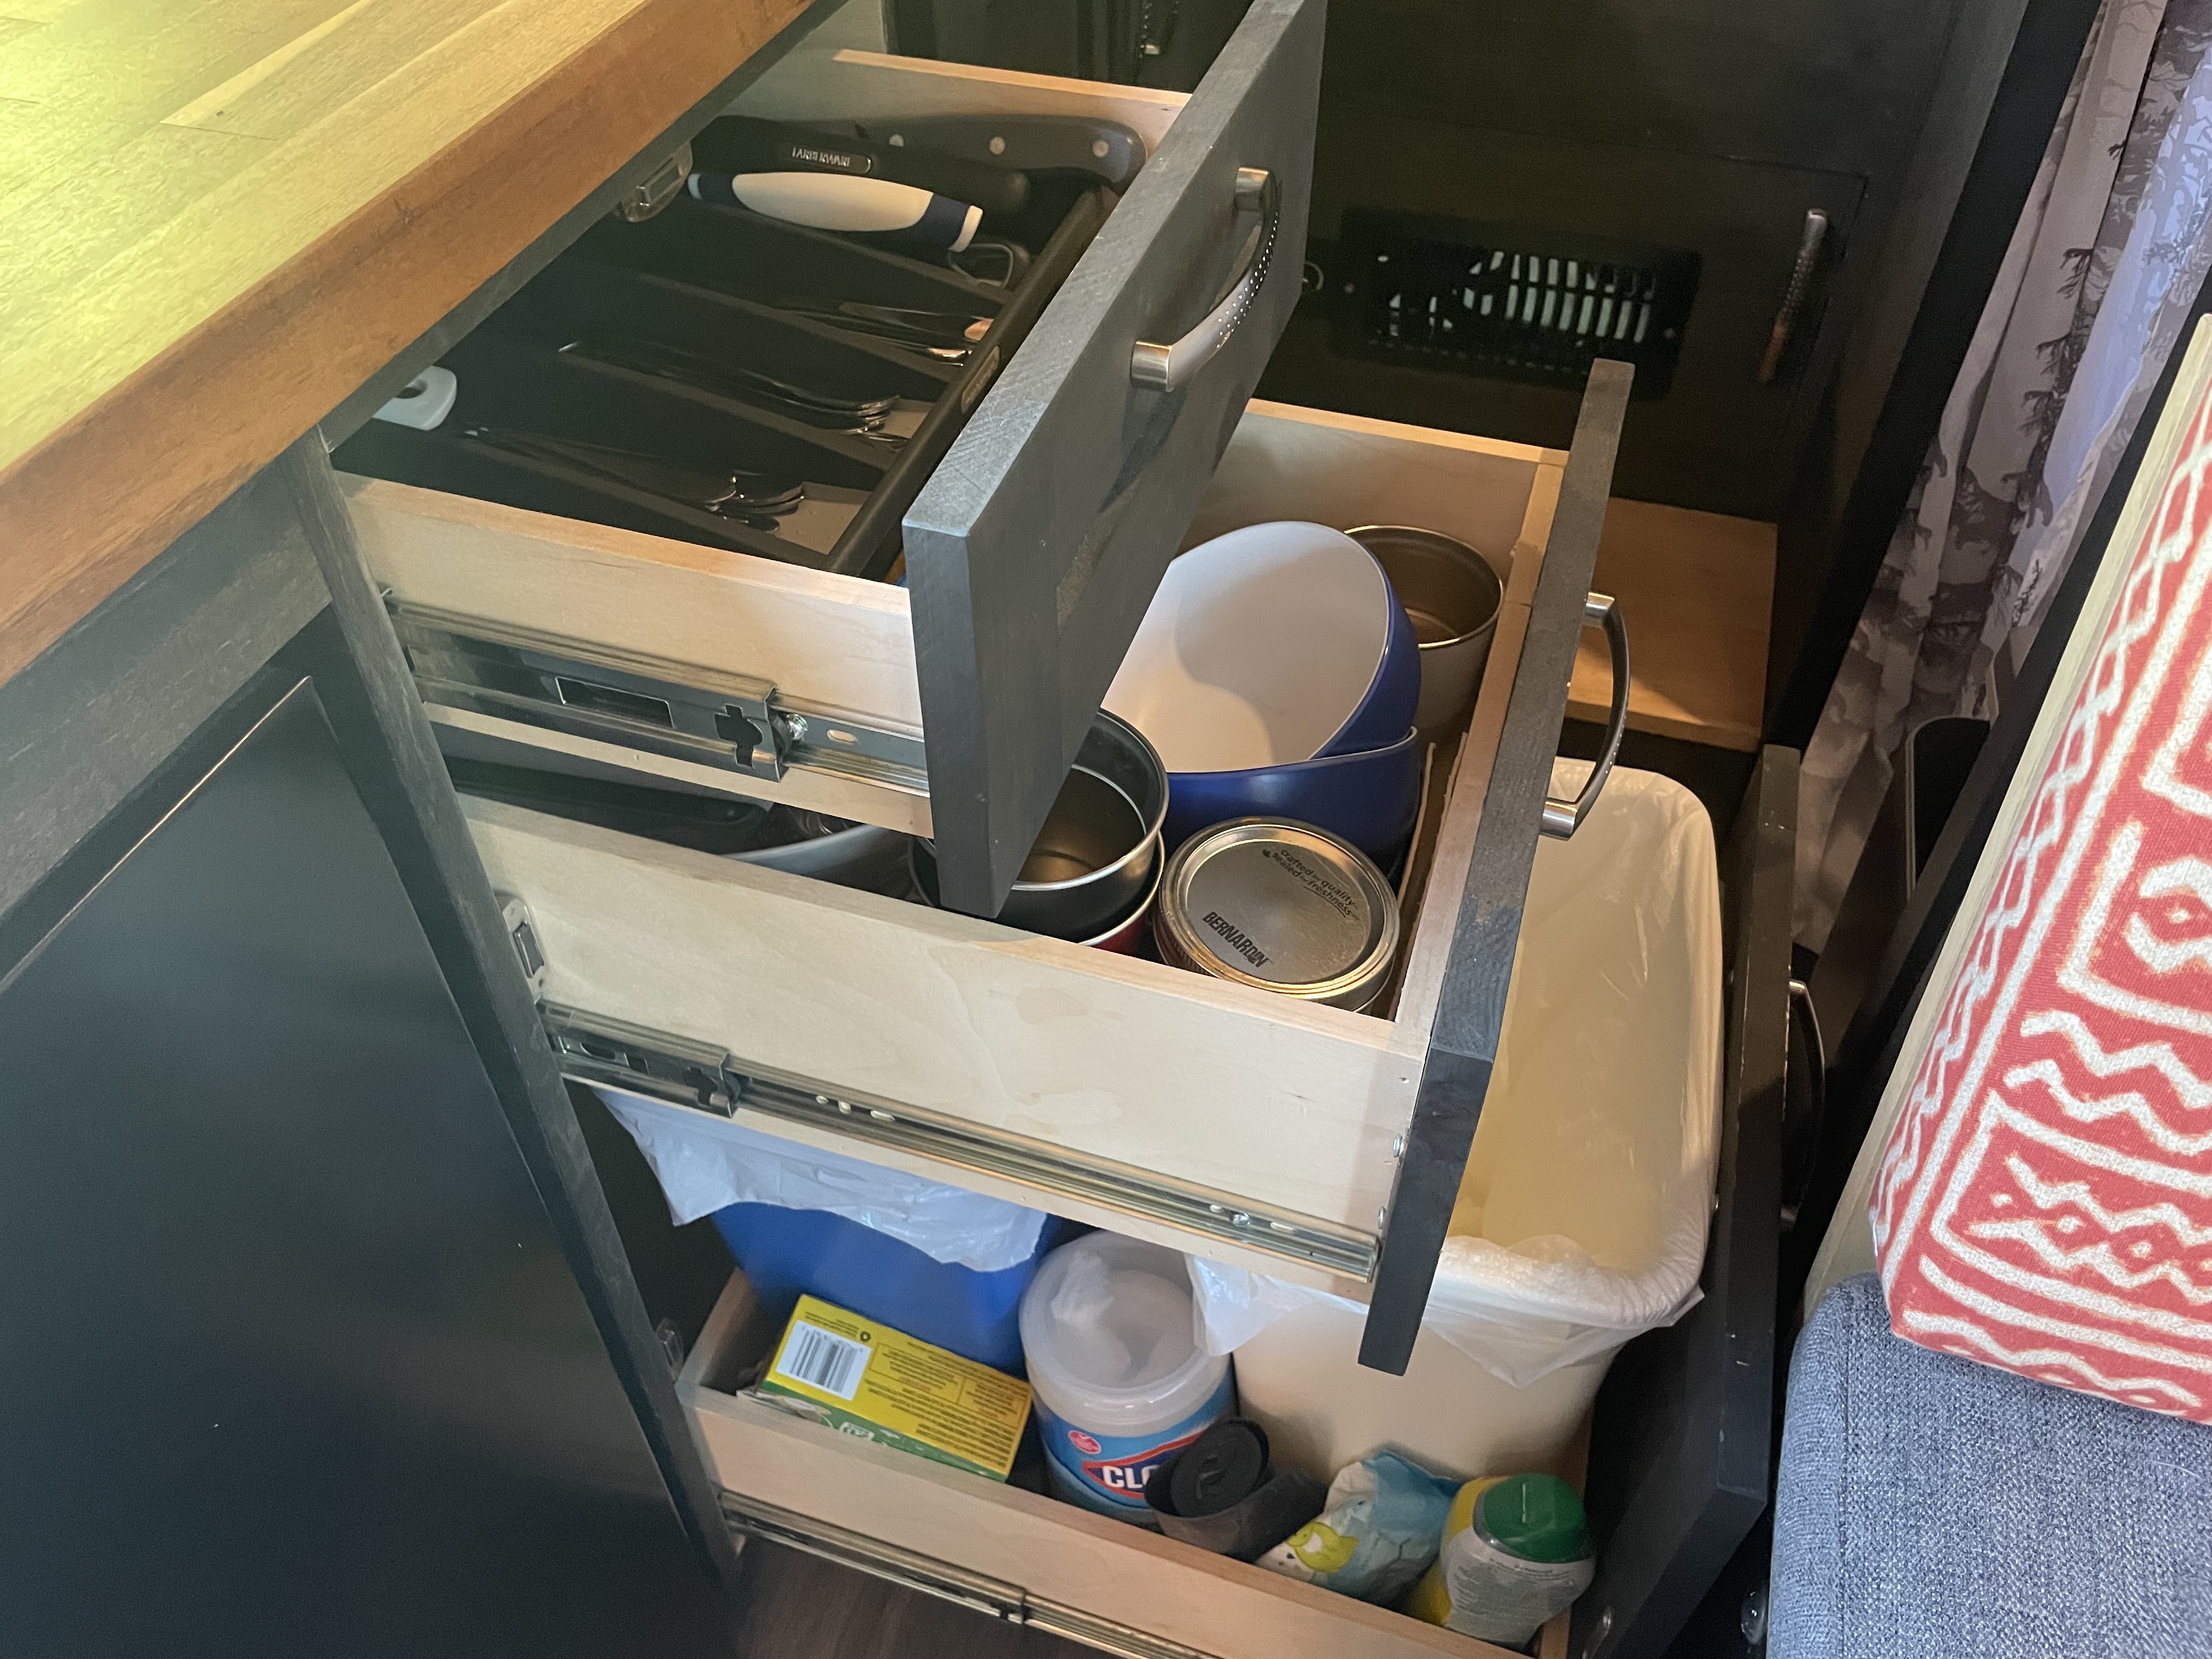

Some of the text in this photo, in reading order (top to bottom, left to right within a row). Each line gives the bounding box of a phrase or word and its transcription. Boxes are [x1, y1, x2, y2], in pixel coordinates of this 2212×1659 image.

[1272, 853, 1302, 877] sealed
[1307, 881, 1352, 916] freshness
[1281, 849, 1313, 876] crafted
[1321, 880, 1356, 906] quality
[1202, 911, 1269, 968] BERNARDIN
